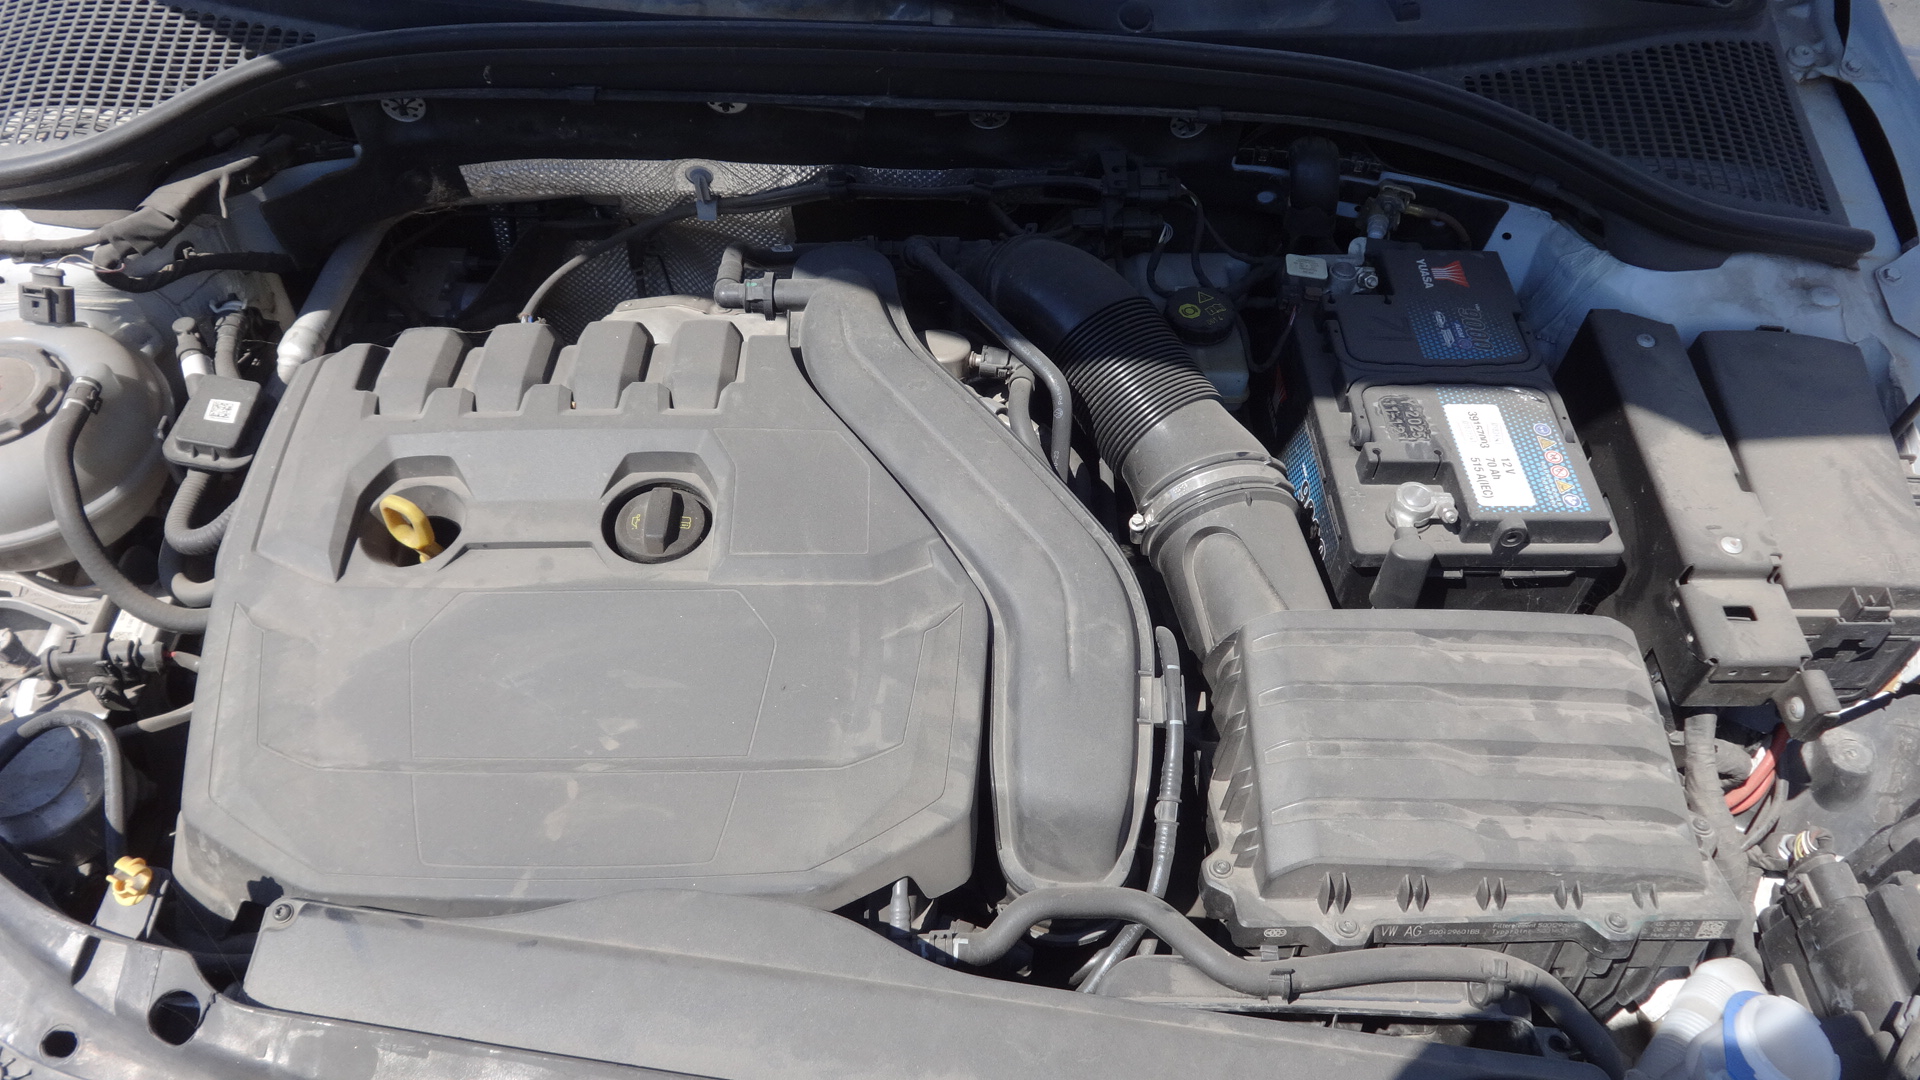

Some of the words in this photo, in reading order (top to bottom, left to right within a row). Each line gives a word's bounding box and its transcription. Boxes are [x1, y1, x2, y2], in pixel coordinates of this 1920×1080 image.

[1416, 258, 1434, 289] YUASA
[1458, 307, 1495, 351] 9000
[1471, 457, 1485, 472] 515
[1485, 458, 1498, 468] 70
[1501, 458, 1513, 468] 12
[1490, 469, 1502, 480] Ah
[1476, 474, 1494, 499] A(IEC)
[1381, 925, 1398, 937] VW
[1404, 925, 1422, 937] AG
